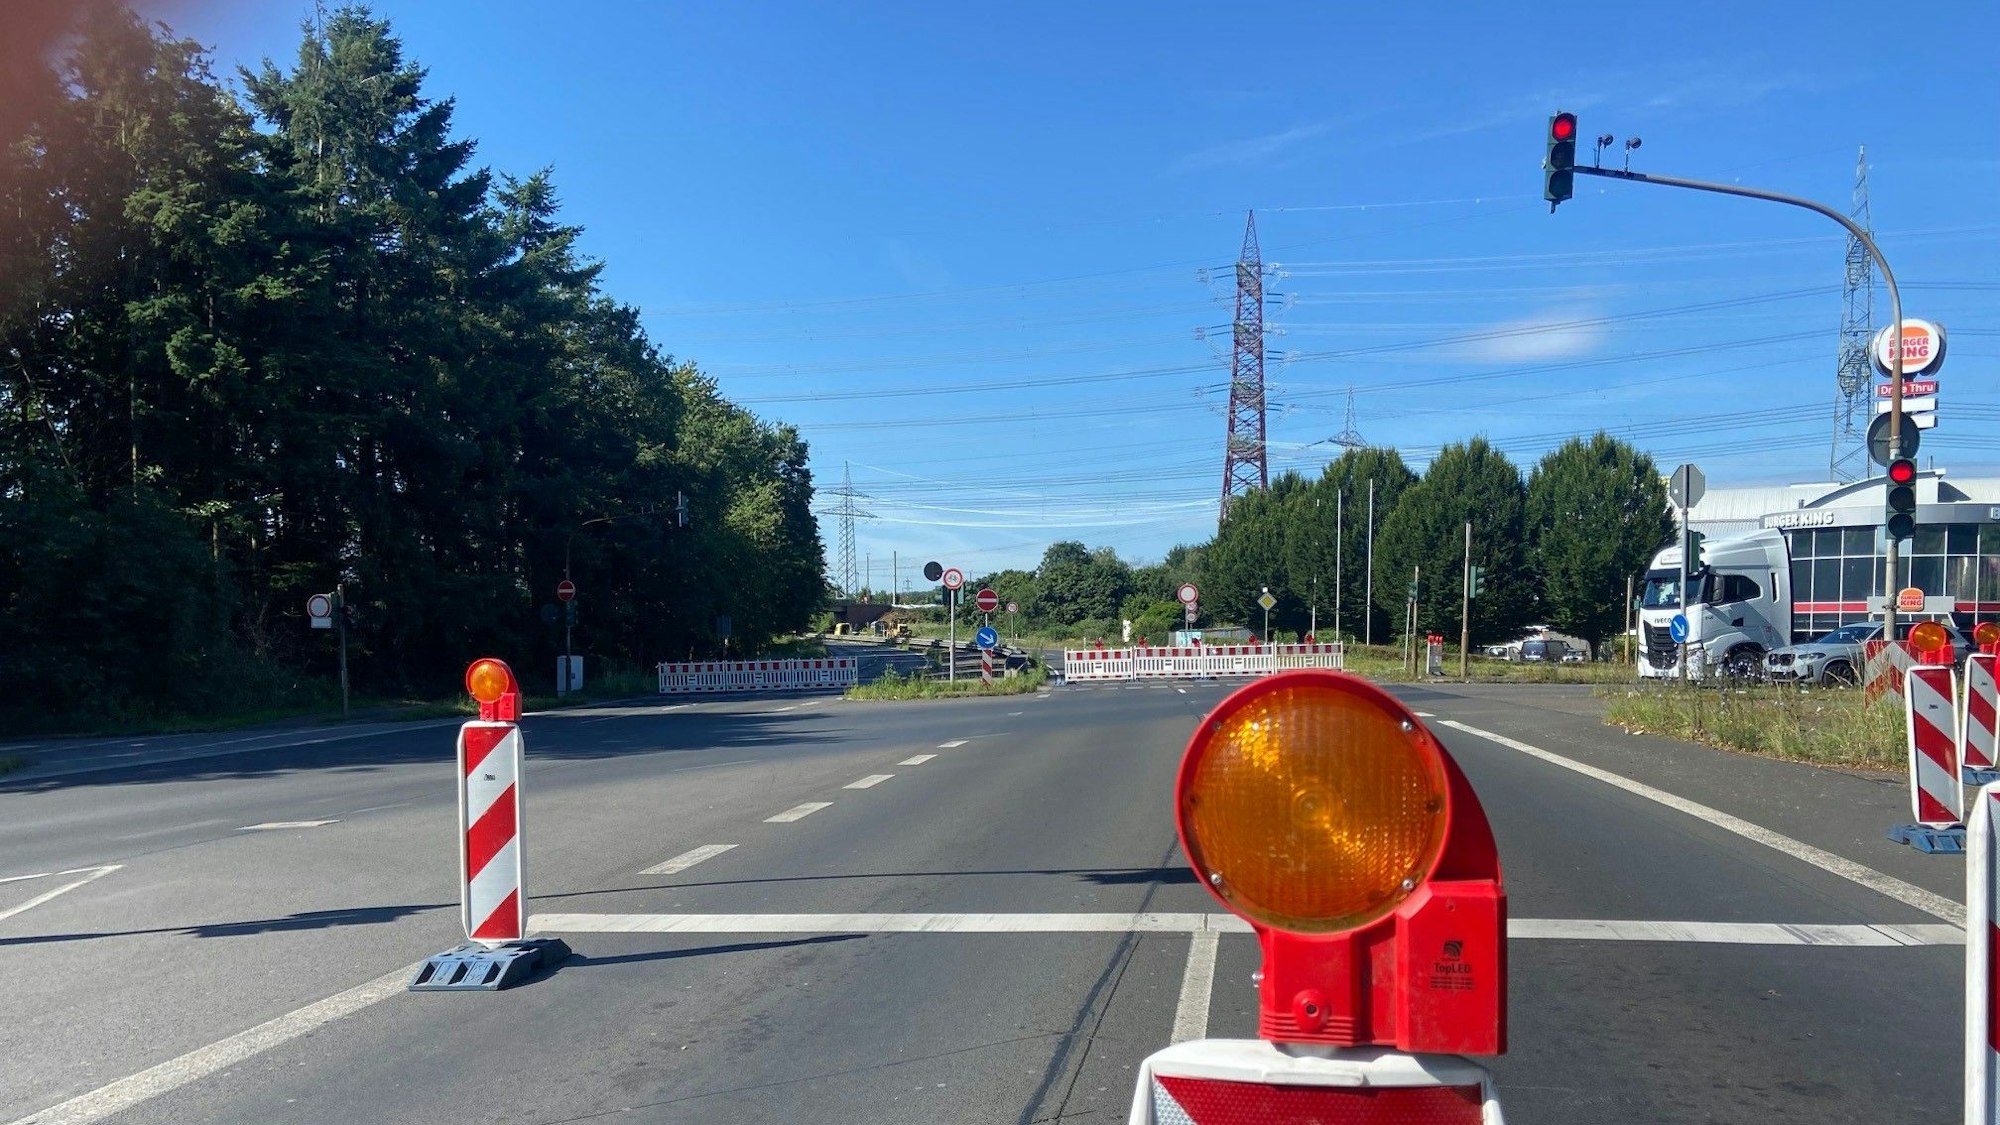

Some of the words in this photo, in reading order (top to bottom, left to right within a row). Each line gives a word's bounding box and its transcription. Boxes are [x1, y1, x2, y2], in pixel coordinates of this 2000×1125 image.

[1889, 338, 1929, 348] BRGER
[1880, 386, 1908, 395] Dre
[1909, 384, 1934, 393] Thru
[1764, 513, 1799, 529] BURGER
[1800, 511, 1835, 527] KING
[1433, 962, 1472, 976] TopLED
